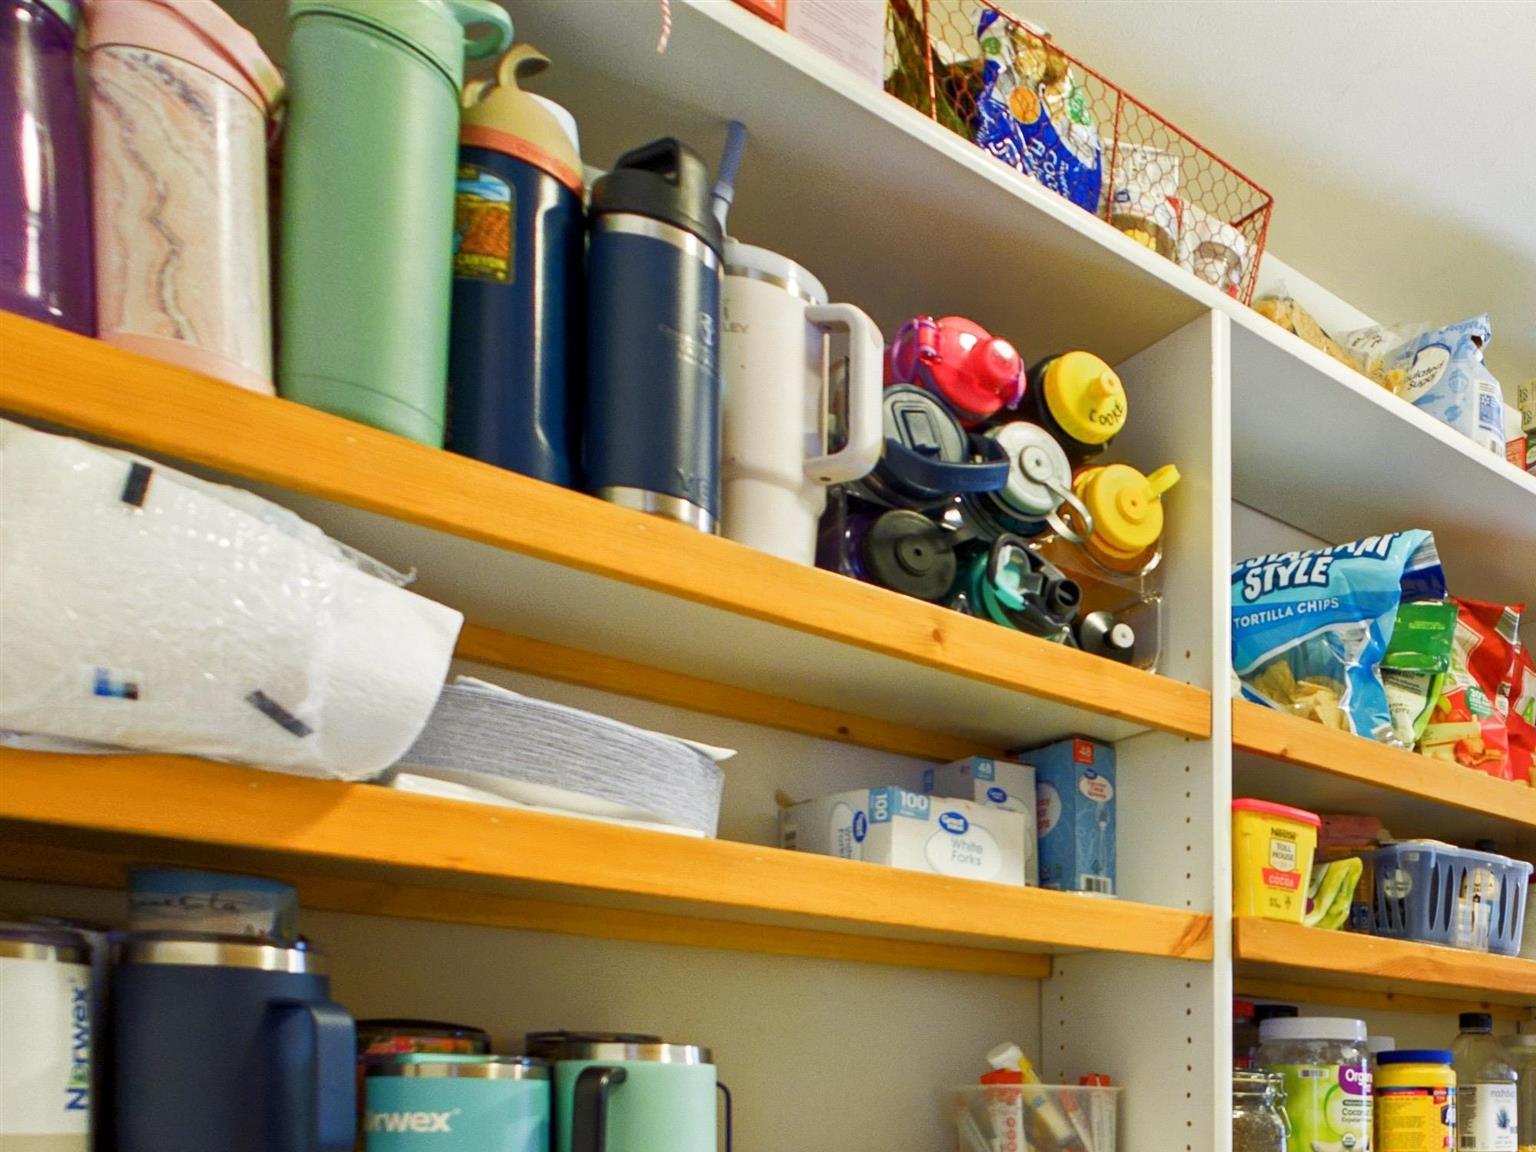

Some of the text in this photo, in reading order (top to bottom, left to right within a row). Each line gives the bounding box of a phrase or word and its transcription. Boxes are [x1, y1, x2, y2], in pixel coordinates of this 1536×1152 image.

[1243, 556, 1334, 601] STYLE
[1233, 597, 1340, 630] TORTILLA CHIPS
[874, 793, 890, 821] 100
[900, 791, 929, 811] 100
[951, 850, 982, 866] Forks
[952, 838, 984, 856] White
[368, 1111, 453, 1133] rwex
